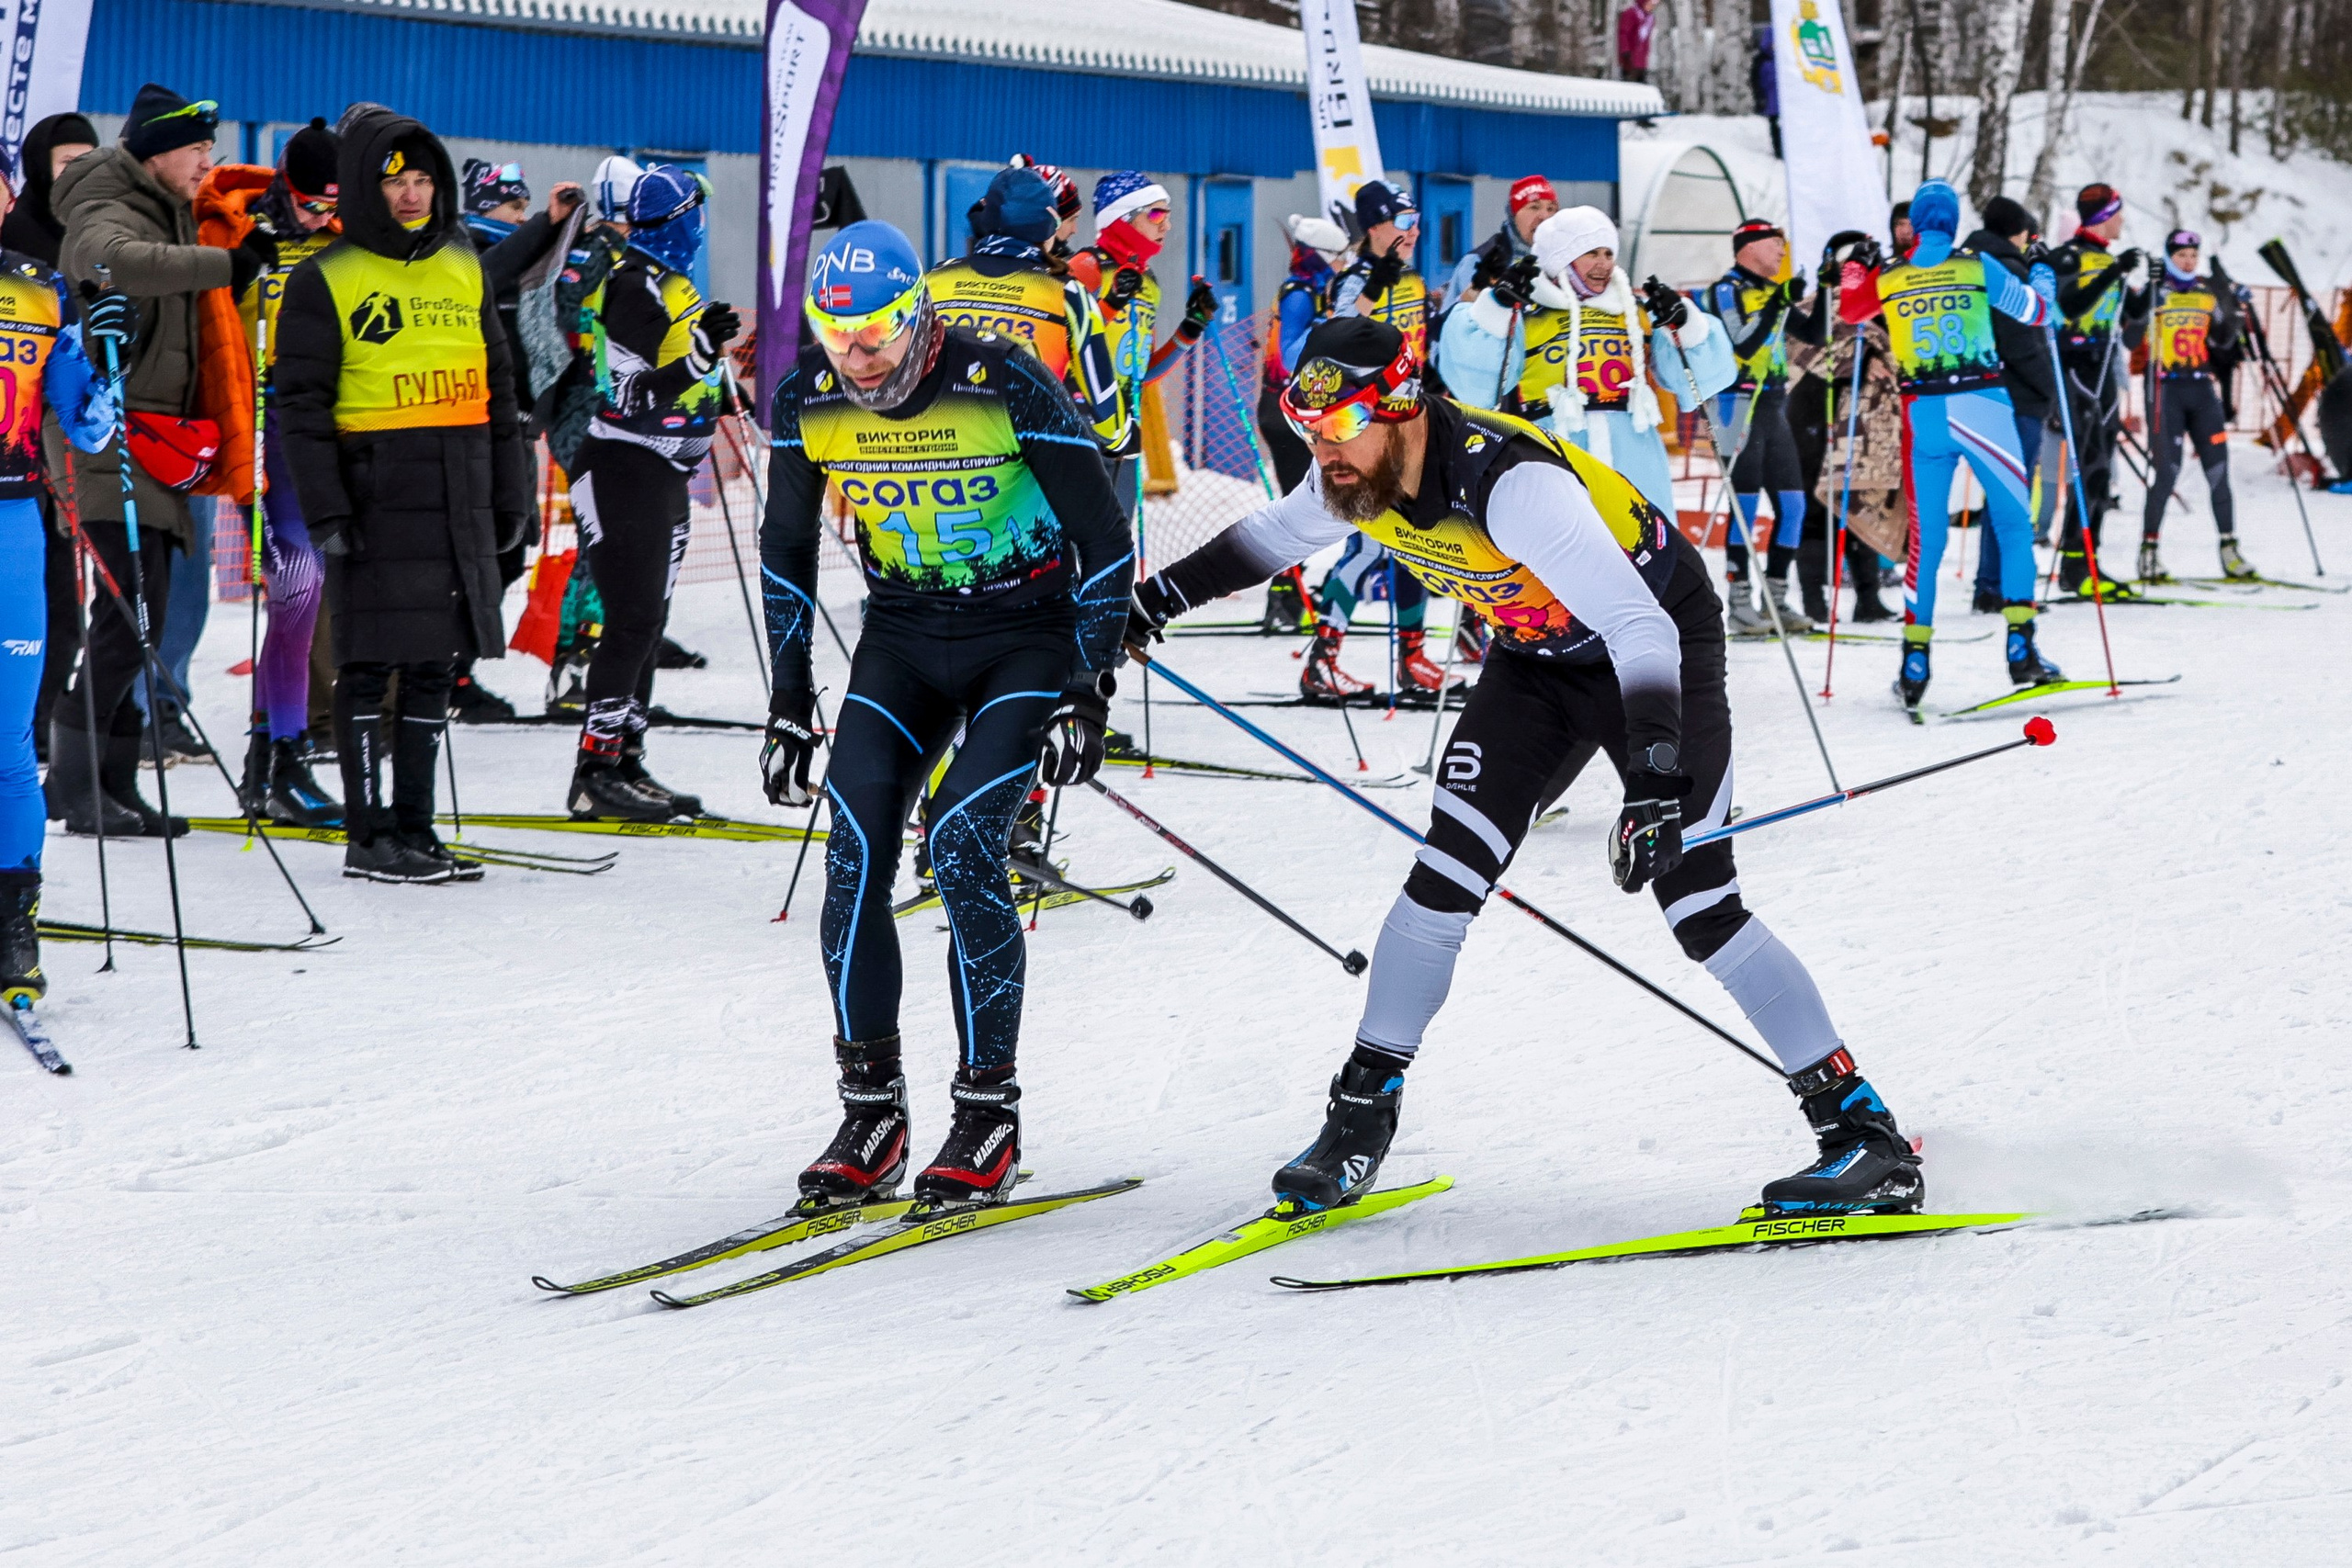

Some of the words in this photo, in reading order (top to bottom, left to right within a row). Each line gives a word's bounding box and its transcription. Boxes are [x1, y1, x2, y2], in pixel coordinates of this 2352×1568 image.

[812, 242, 876, 288] DNB
[954, 279, 1026, 295] ВИКТОРИЯ
[1897, 294, 1973, 318] согаз
[1912, 313, 1967, 360] 58
[393, 368, 480, 408] СУДЬЯ
[855, 428, 956, 444] ВИКТОРИЯ
[891, 459, 961, 473] КОМАНДНЫЙ
[841, 475, 1000, 508] согаз
[876, 508, 994, 568] 15
[1394, 526, 1464, 555] ВИКТОРИЯ
[1401, 562, 1524, 604] огаз
[616, 822, 698, 837] FISCHER
[842, 1090, 895, 1101] MADSHUS
[953, 1089, 1007, 1101] MADSHUS
[972, 1123, 1014, 1169] MADSHUS
[805, 1210, 862, 1235] FISCHER
[922, 1213, 977, 1240] FISCHER
[1286, 1214, 1328, 1237] FISCHER
[1753, 1219, 1846, 1238] FISCHER
[1100, 1263, 1177, 1292] FISCHER
